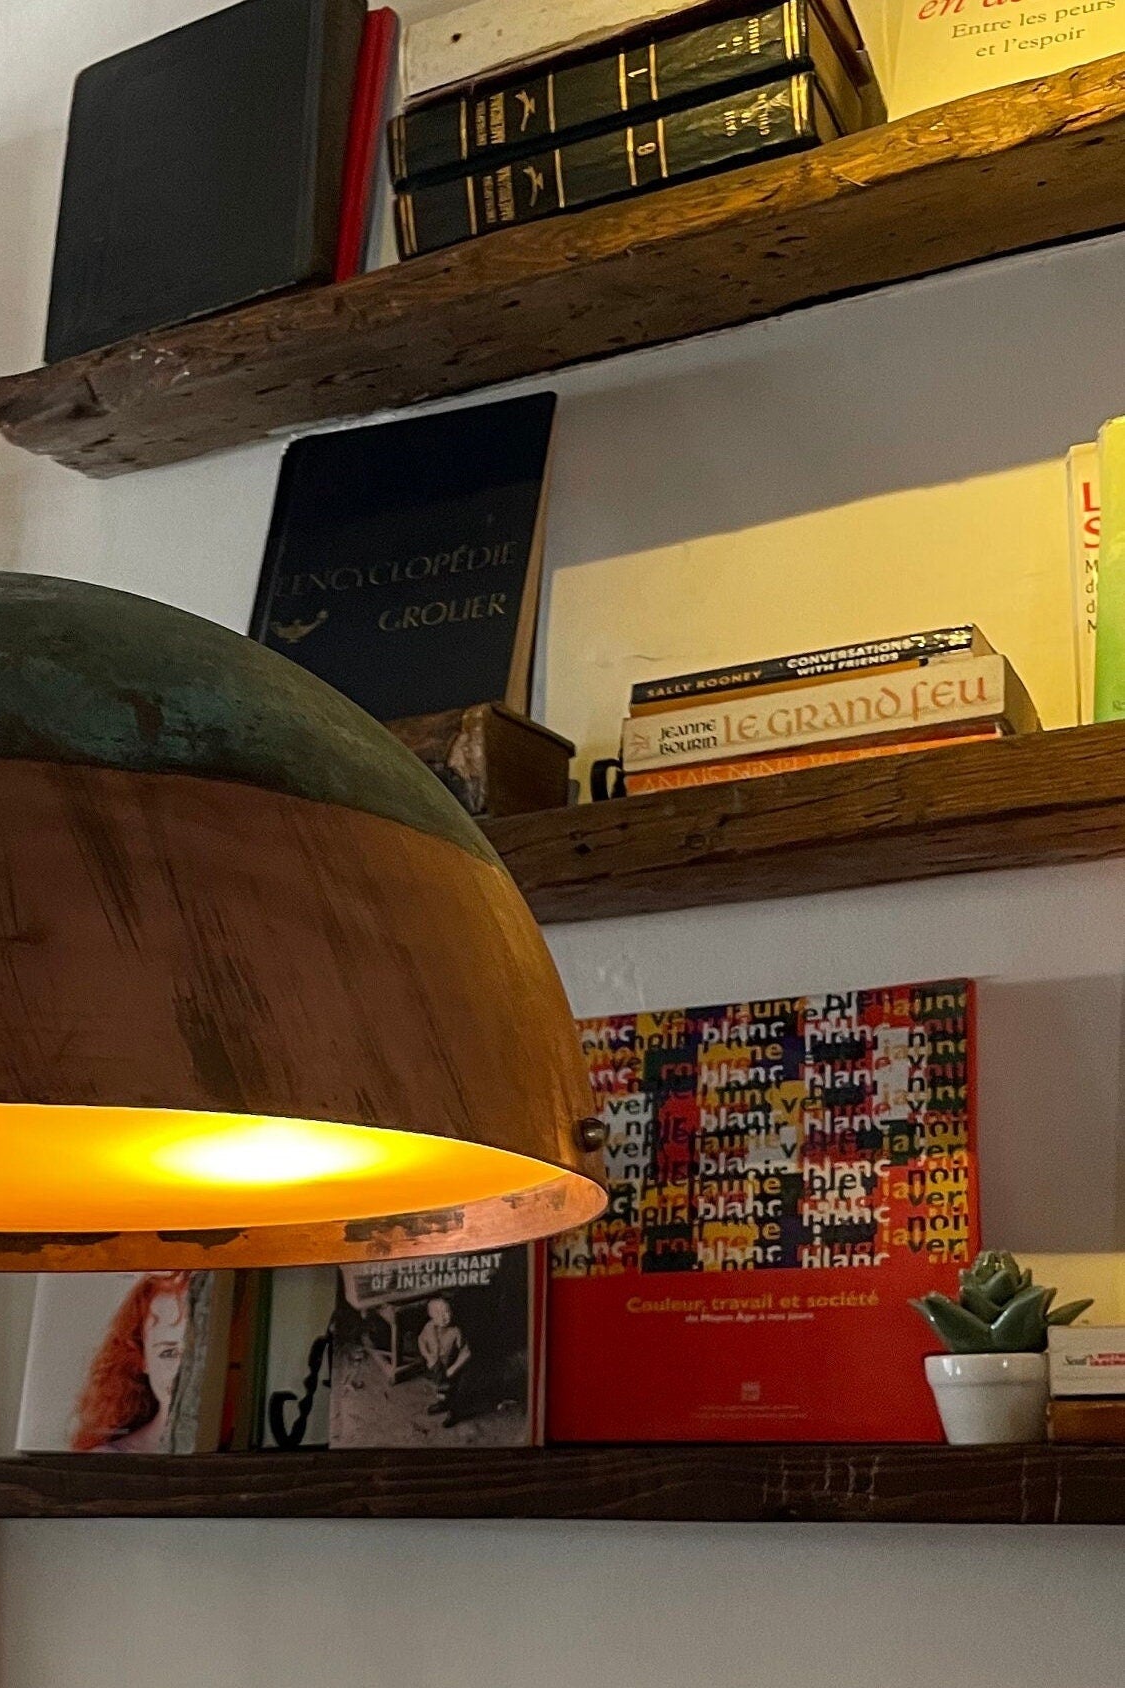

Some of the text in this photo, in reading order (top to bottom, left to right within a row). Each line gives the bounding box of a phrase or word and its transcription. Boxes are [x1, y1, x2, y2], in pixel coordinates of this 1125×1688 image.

[951, 0, 1116, 39] Entre les peurs
[976, 43, 995, 57] et
[627, 67, 649, 78] 1
[378, 591, 506, 632] GROLIER
[786, 637, 914, 669] CONVERSATIONS
[796, 651, 899, 676] WITH FRIENDS
[647, 669, 763, 698] SALLY ROONEY
[658, 719, 717, 742] JEANNE
[658, 735, 718, 757] BOURIN
[702, 1019, 786, 1045] blanc
[397, 1253, 503, 1274] LIEUTENANT
[370, 1269, 491, 1292] OF INISHMORE
[626, 1289, 880, 1314] Couleur, travail et société
